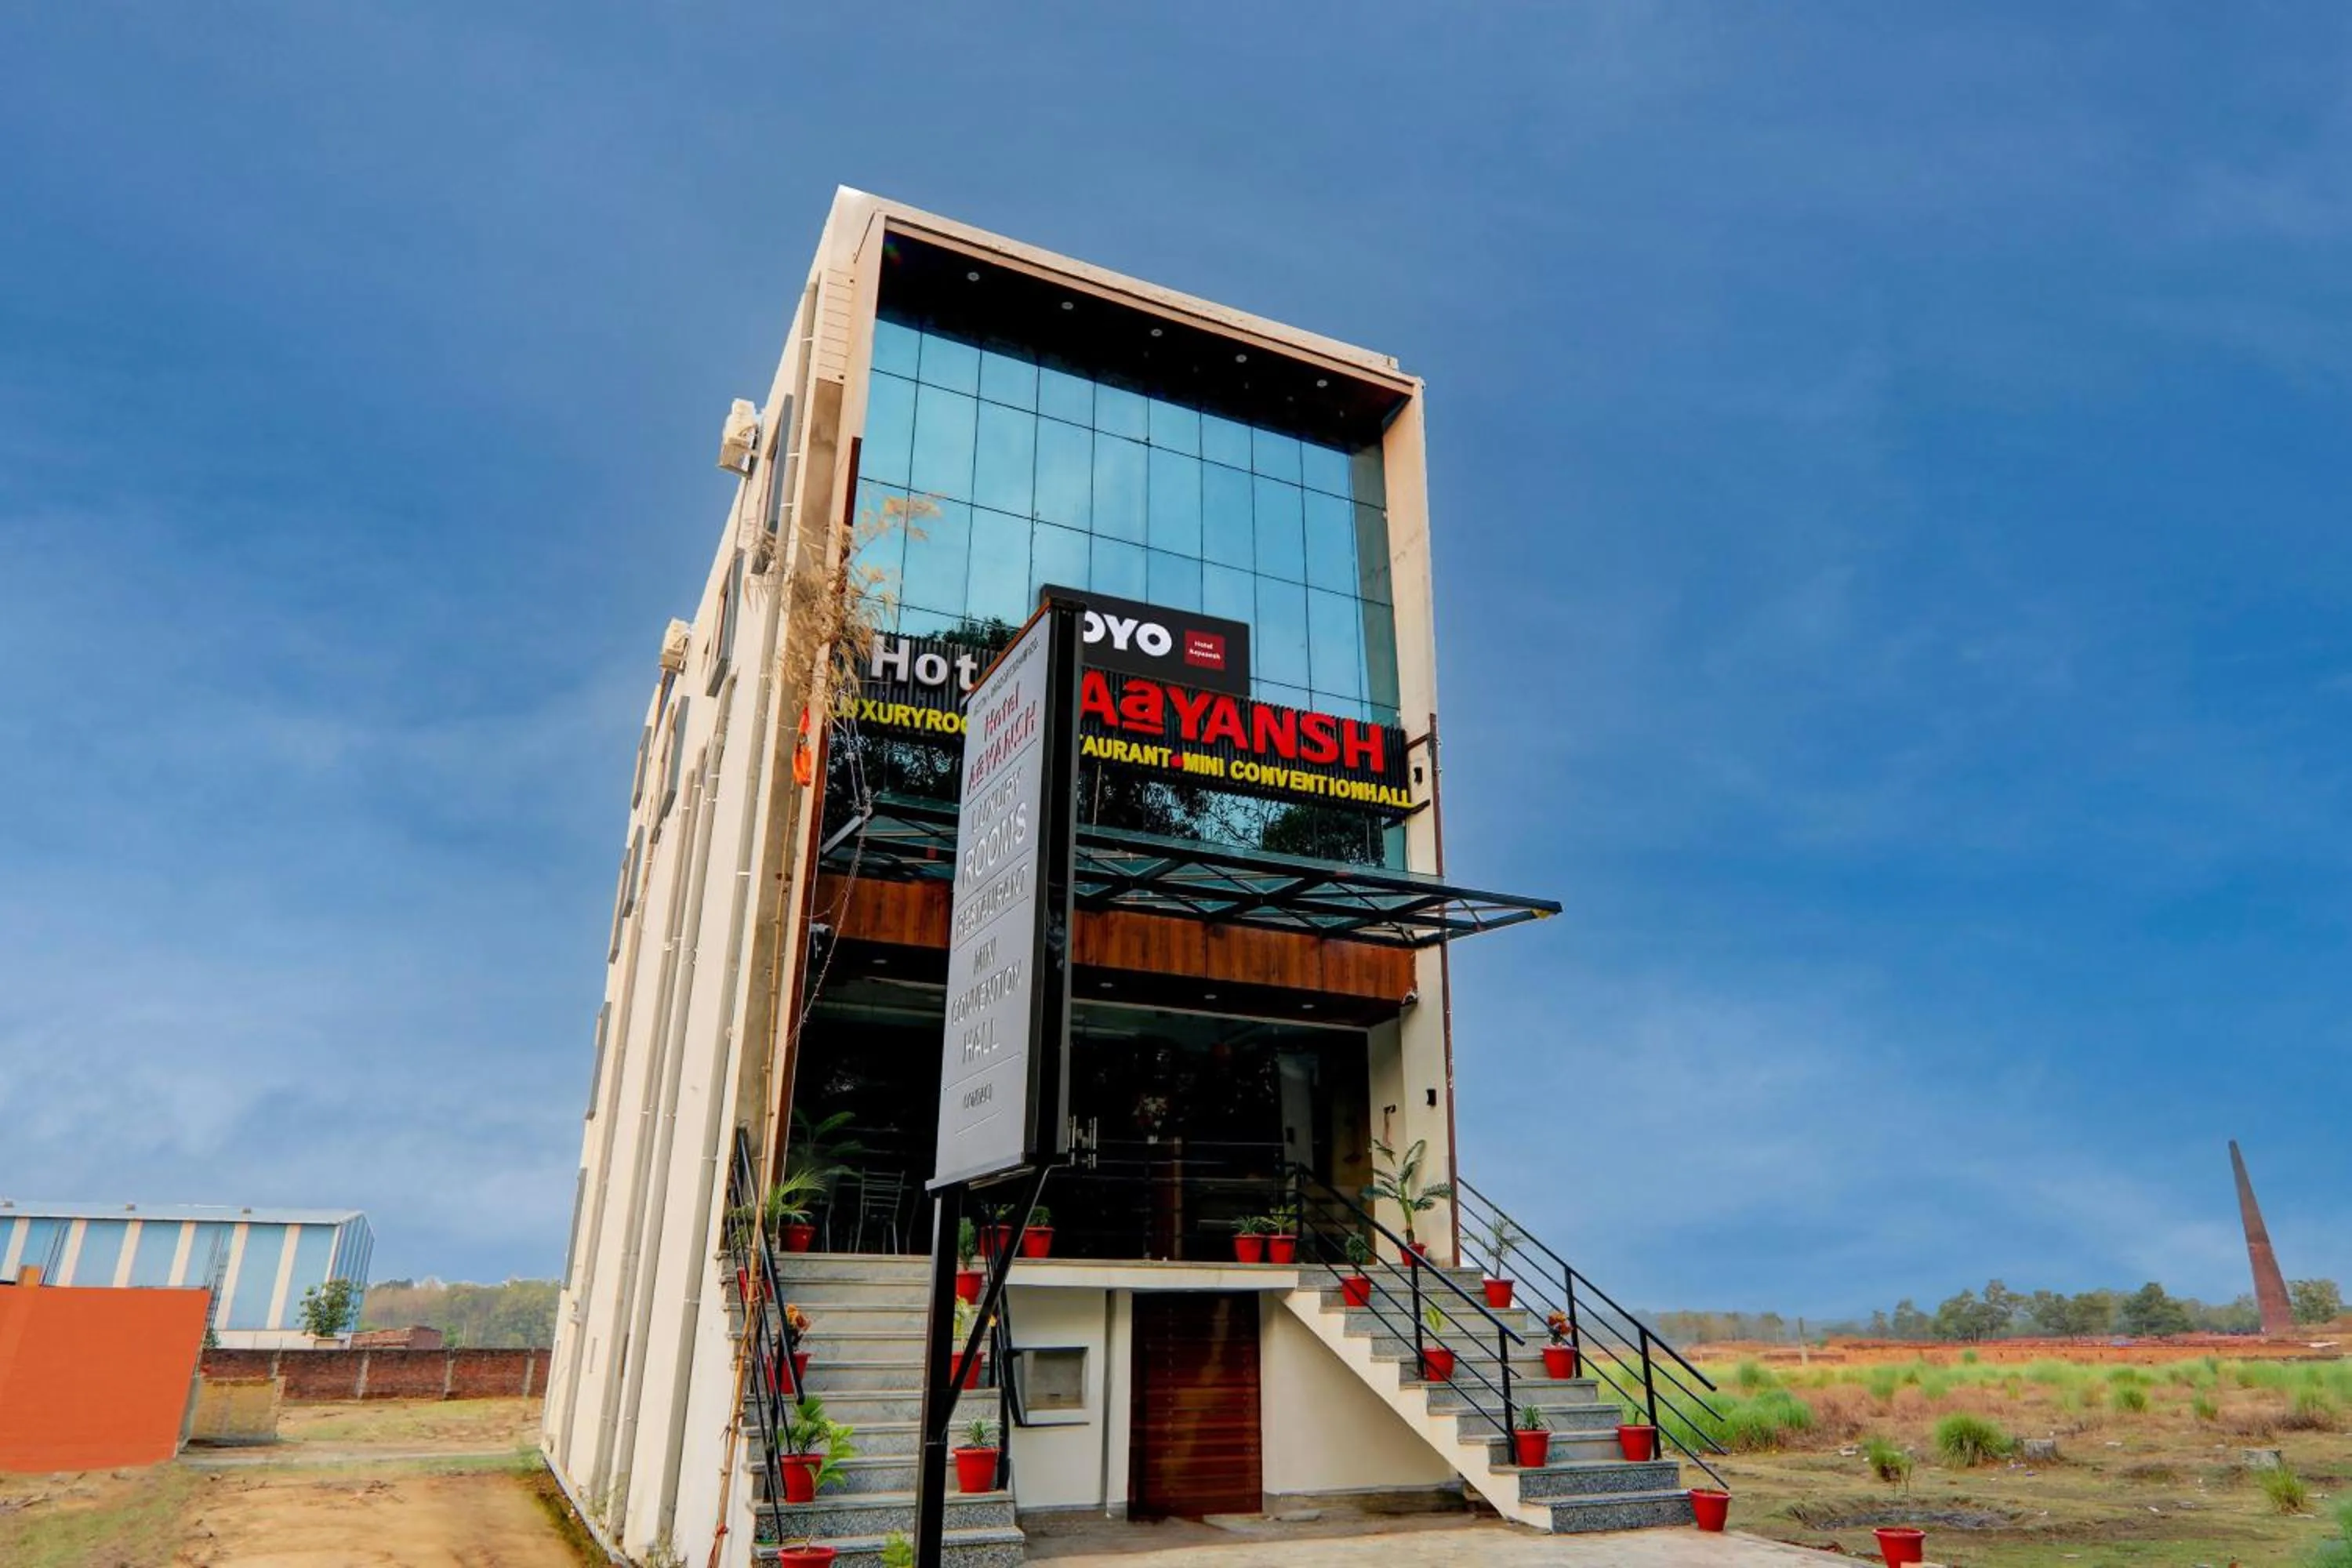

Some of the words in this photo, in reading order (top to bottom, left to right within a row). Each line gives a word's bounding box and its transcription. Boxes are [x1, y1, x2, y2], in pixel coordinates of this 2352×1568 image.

[869, 633, 978, 691] Hot
[1083, 609, 1172, 657] OYO
[1079, 734, 1172, 768] AURANT
[1182, 752, 1225, 777] MINI
[971, 767, 1022, 834] LUXURY
[962, 802, 1027, 889] ROOMS
[956, 866, 1028, 941] RESTAURANT
[973, 937, 996, 976] MINI
[951, 960, 1022, 1027] CONVENTION
[962, 1017, 1000, 1065] HALL
